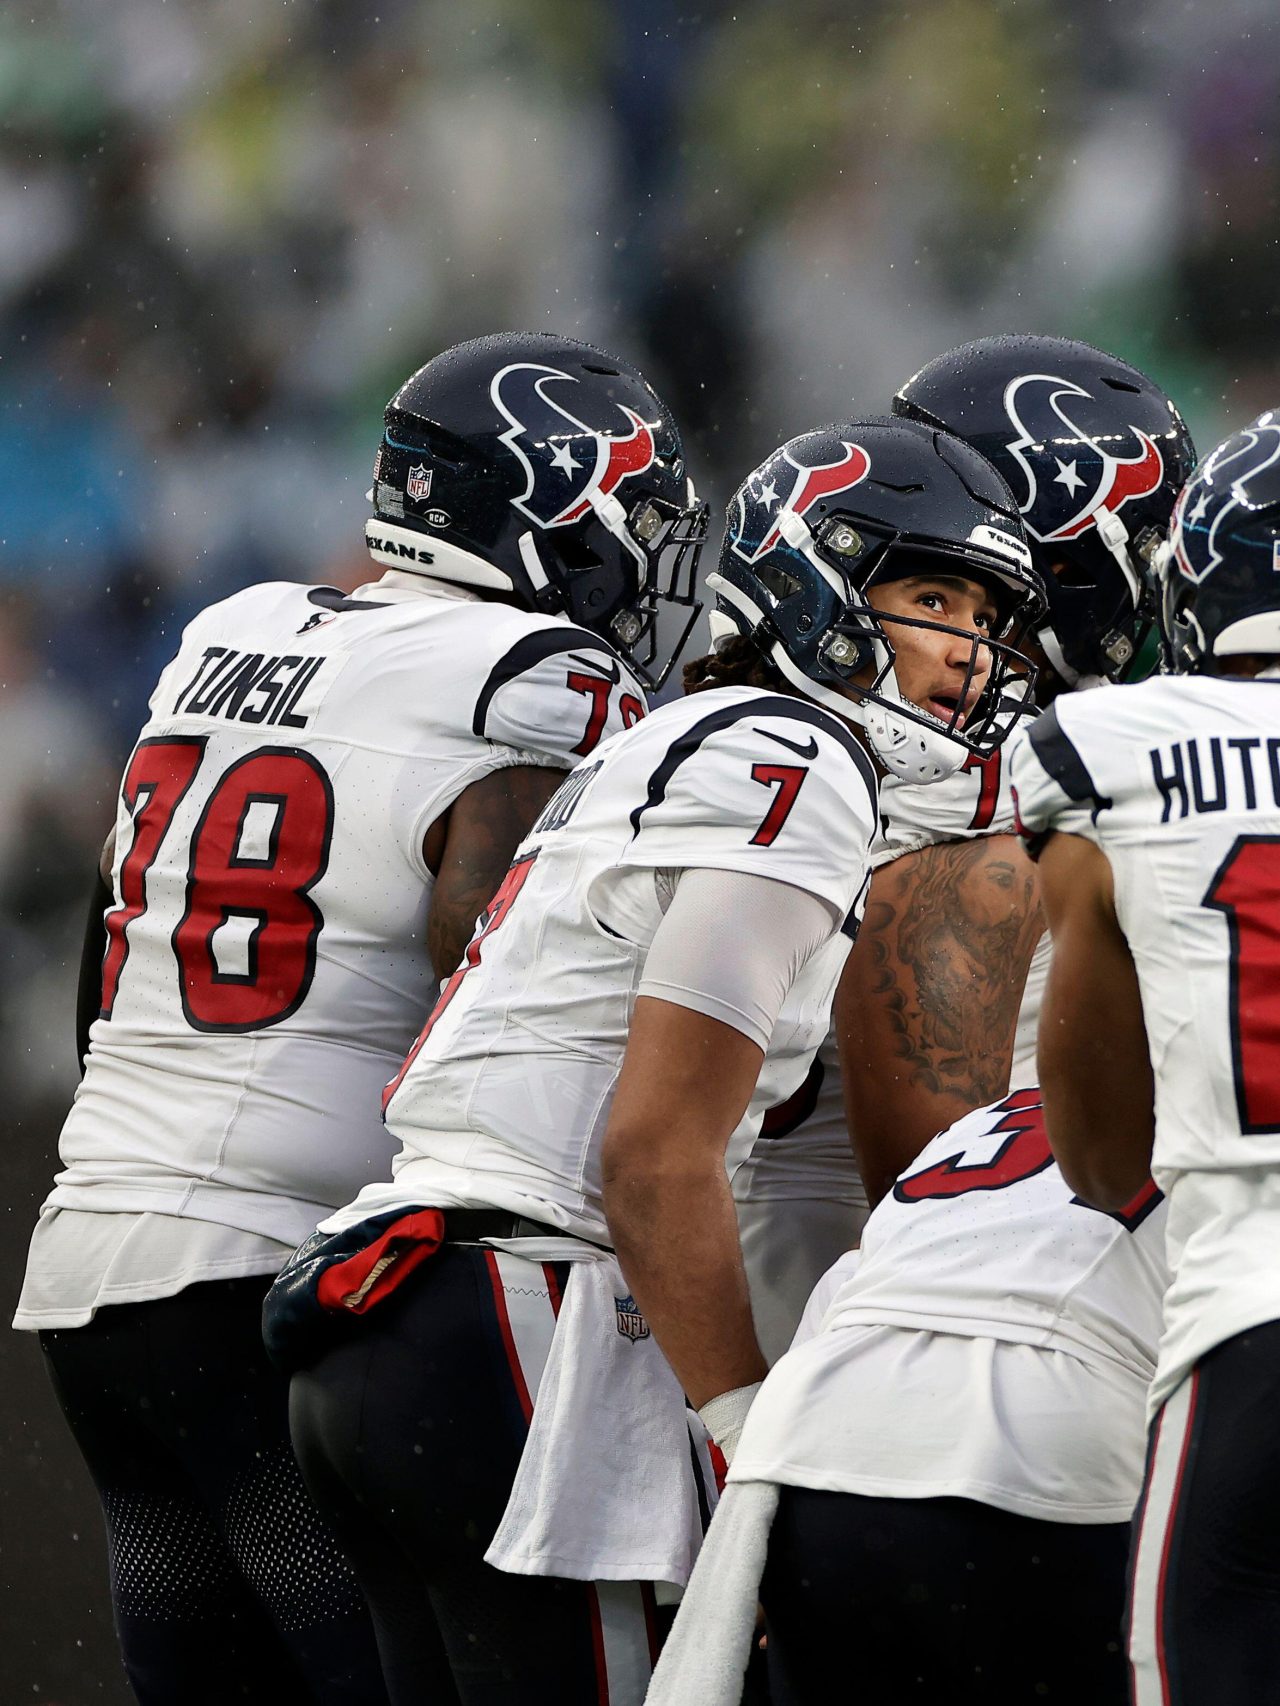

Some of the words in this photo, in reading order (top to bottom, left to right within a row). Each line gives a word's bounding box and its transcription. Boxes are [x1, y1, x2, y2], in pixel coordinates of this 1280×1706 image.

[410, 481, 429, 495] NFL
[366, 535, 435, 565] EXANS
[172, 647, 327, 729] TUNSIL
[749, 763, 810, 847] 7
[99, 735, 335, 1034] 78
[619, 1313, 648, 1336] NFL
